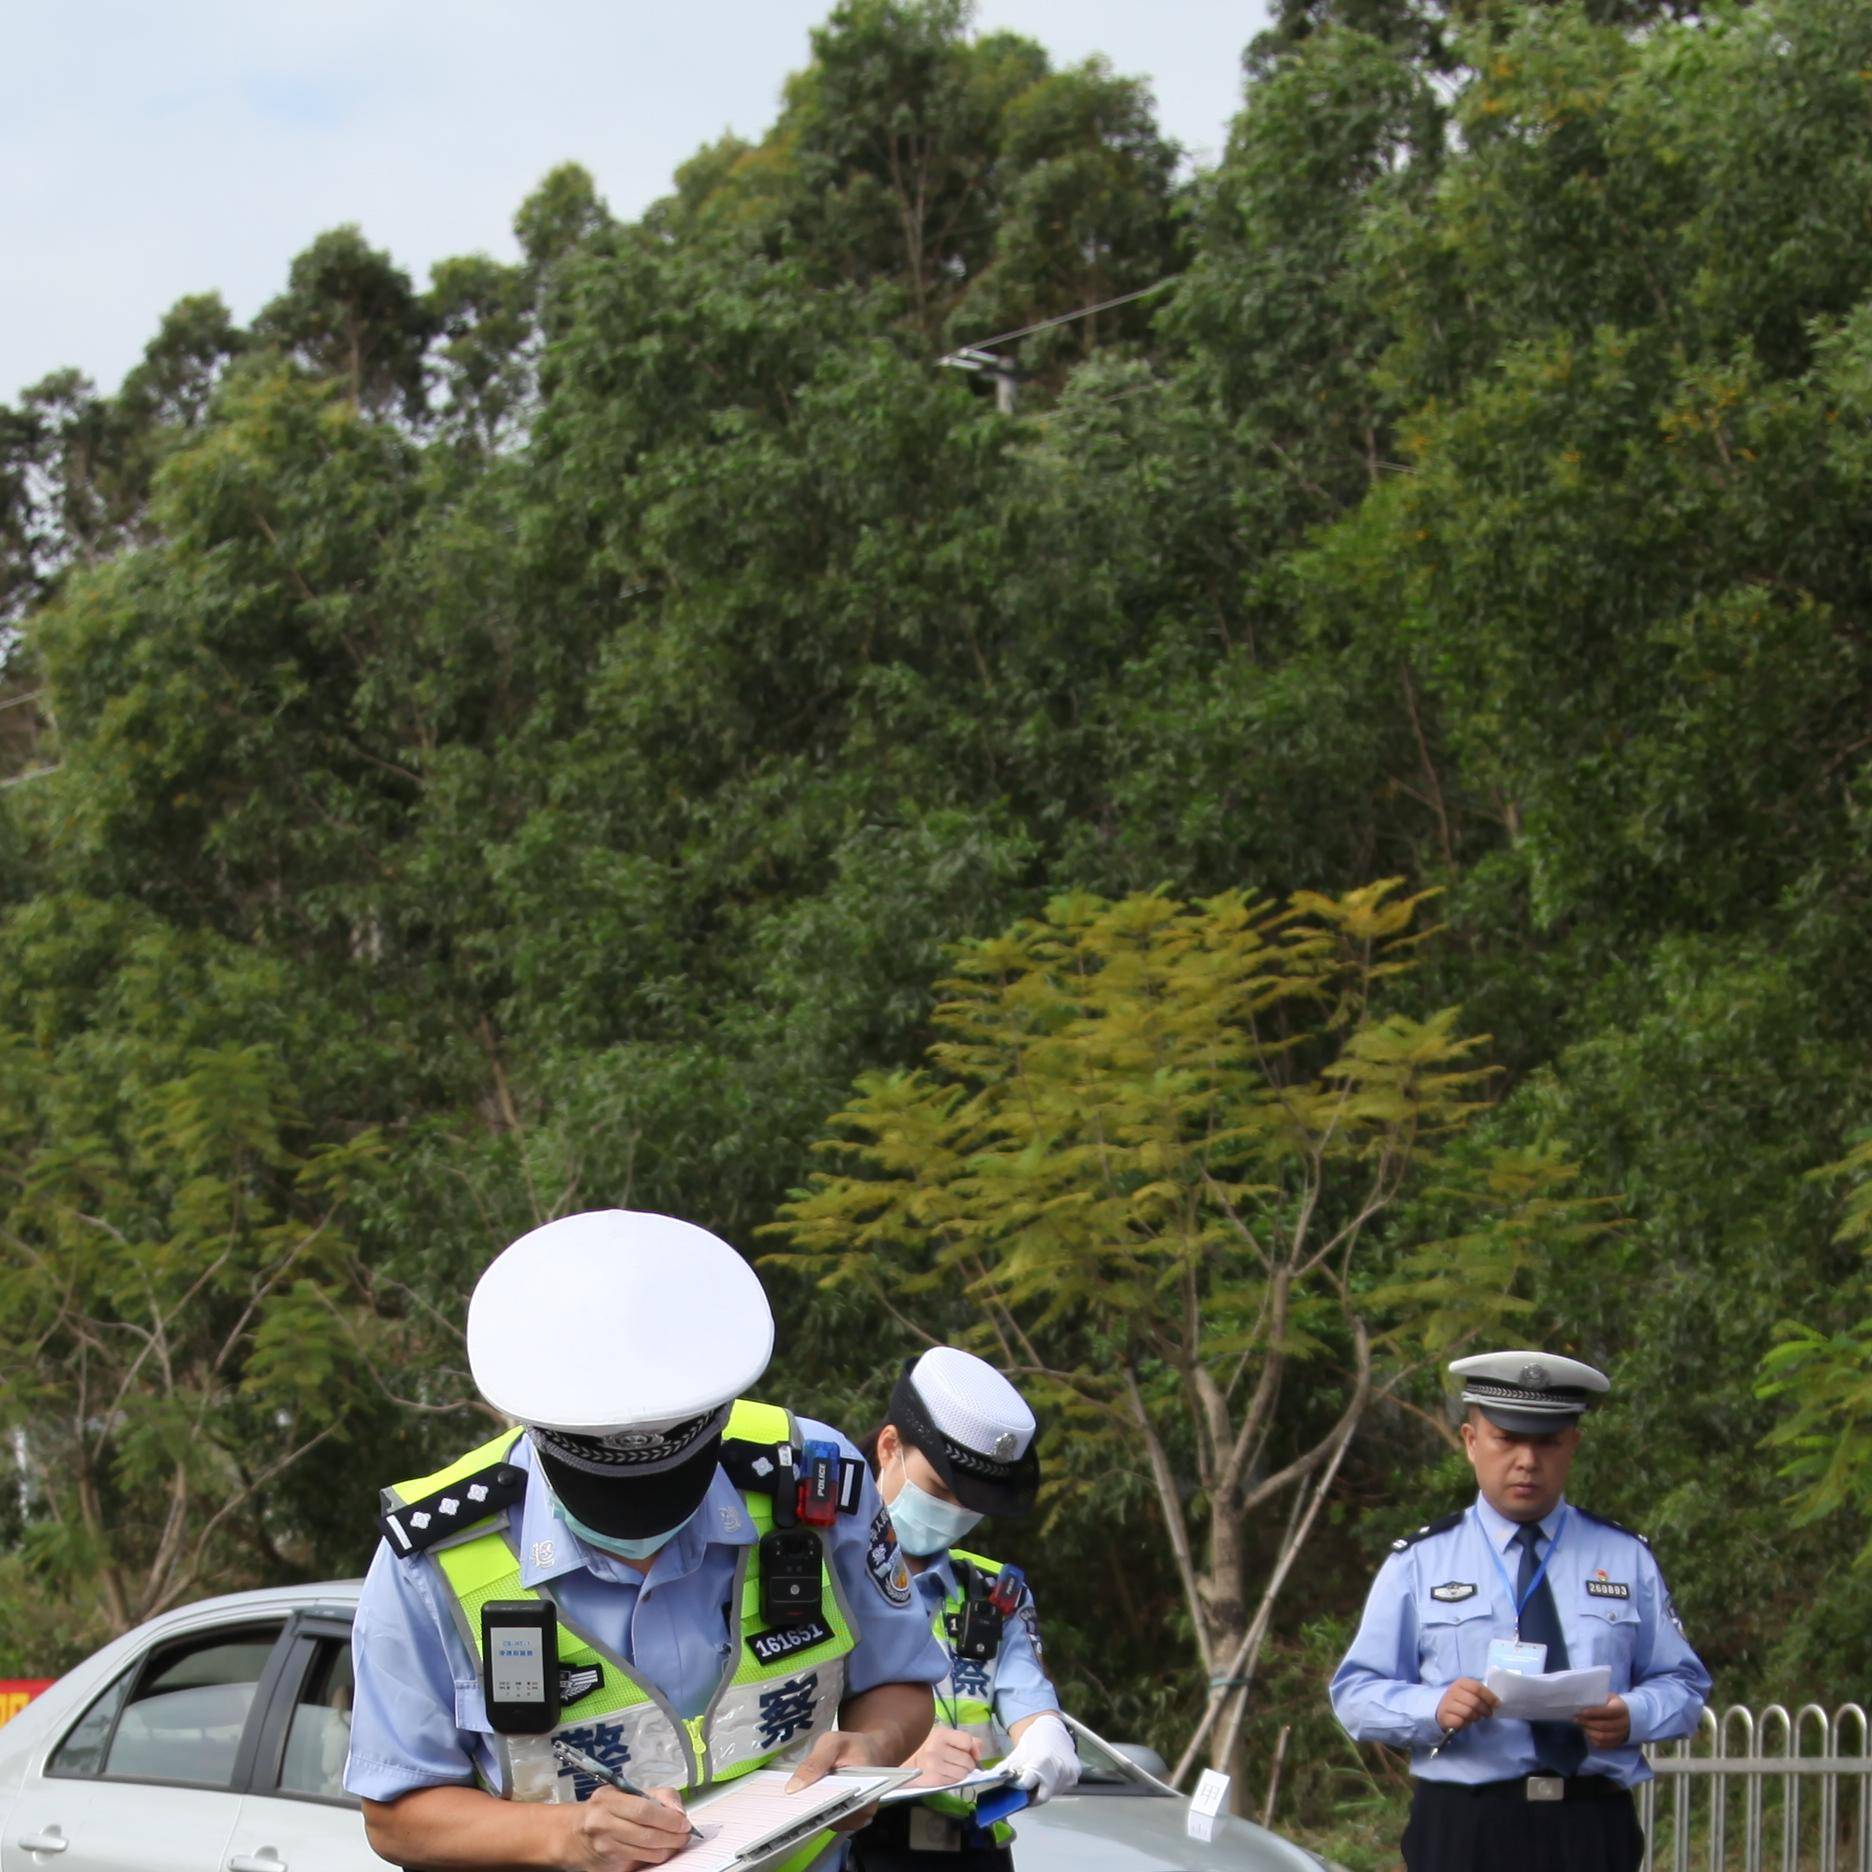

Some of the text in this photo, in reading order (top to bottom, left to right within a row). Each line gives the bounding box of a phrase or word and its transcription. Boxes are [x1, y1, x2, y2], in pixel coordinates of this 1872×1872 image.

[817, 1463, 827, 1497] POLICE
[755, 1622, 825, 1658] 161651
[758, 1671, 820, 1750] 察
